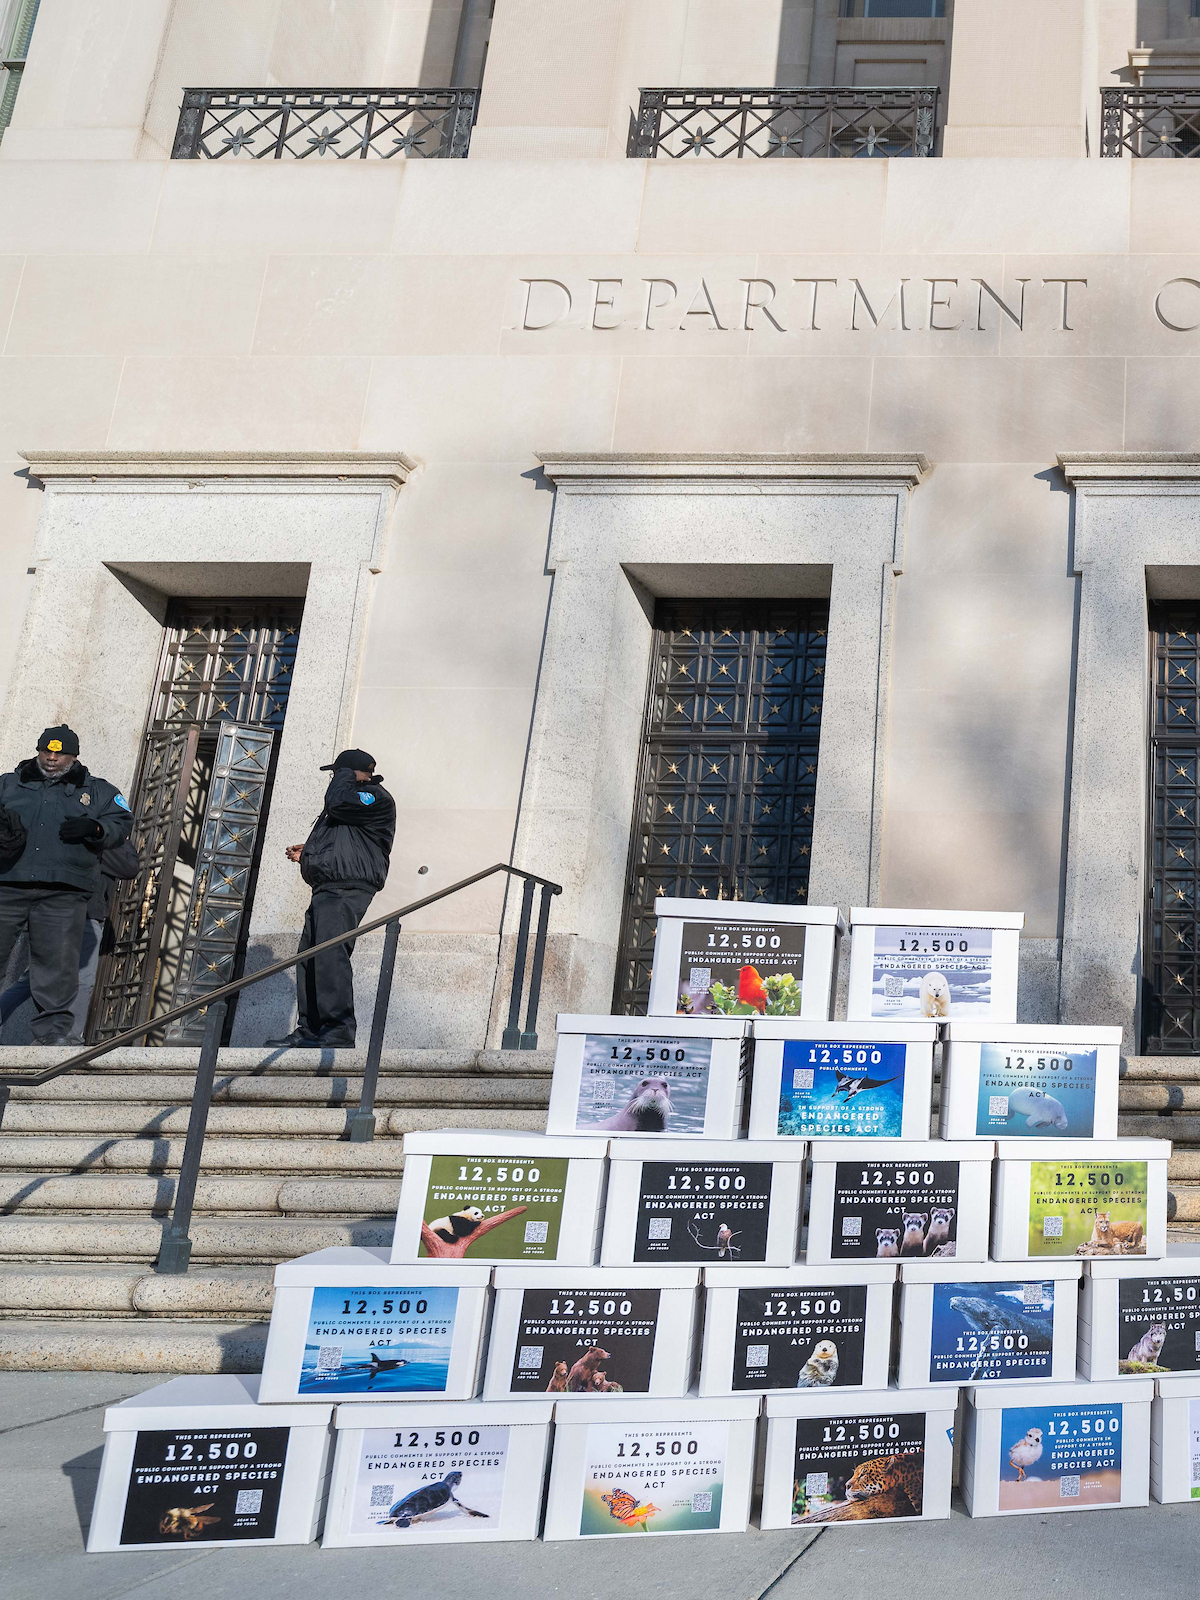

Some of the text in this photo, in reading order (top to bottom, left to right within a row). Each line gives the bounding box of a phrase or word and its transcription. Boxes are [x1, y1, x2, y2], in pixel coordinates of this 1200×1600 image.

[511, 278, 1088, 332] DEPARTMENT
[708, 934, 780, 948] 12,500
[900, 940, 968, 953] 12,500
[611, 1047, 684, 1061] 12,500
[809, 1049, 881, 1064] 12,500
[1005, 1057, 1072, 1071] 12,500
[802, 1112, 879, 1120] ENDANGERED
[458, 1166, 540, 1182] 12,500
[861, 1171, 934, 1186] 12,500
[1056, 1173, 1124, 1187] 12,500
[668, 1176, 745, 1191] 12,500
[342, 1300, 427, 1315] 12,500
[550, 1300, 632, 1316] 12,500
[764, 1300, 840, 1316] 12,500
[1125, 1313, 1185, 1322] ENDANGERED
[743, 1327, 812, 1336] ENDANGERED
[957, 1335, 1028, 1351] 12,500
[937, 1360, 1001, 1369] ENDANGERED
[823, 1424, 899, 1442] 12,500
[1048, 1418, 1119, 1435] 12,500
[394, 1431, 479, 1448] 12,500
[165, 1442, 257, 1462] 12,500
[617, 1441, 698, 1457] 12,500
[800, 1450, 858, 1459] ENDANGERED
[863, 1448, 899, 1456] SPECIES
[1052, 1449, 1115, 1458] ENDANGERED
[368, 1461, 445, 1469] ENDANGERED
[1051, 1461, 1092, 1470] SPECIES
[138, 1471, 277, 1484] ENDANGERED SPECIES
[593, 1468, 718, 1479] ENDANGERED SPECIES
[194, 1485, 219, 1494] ACT
